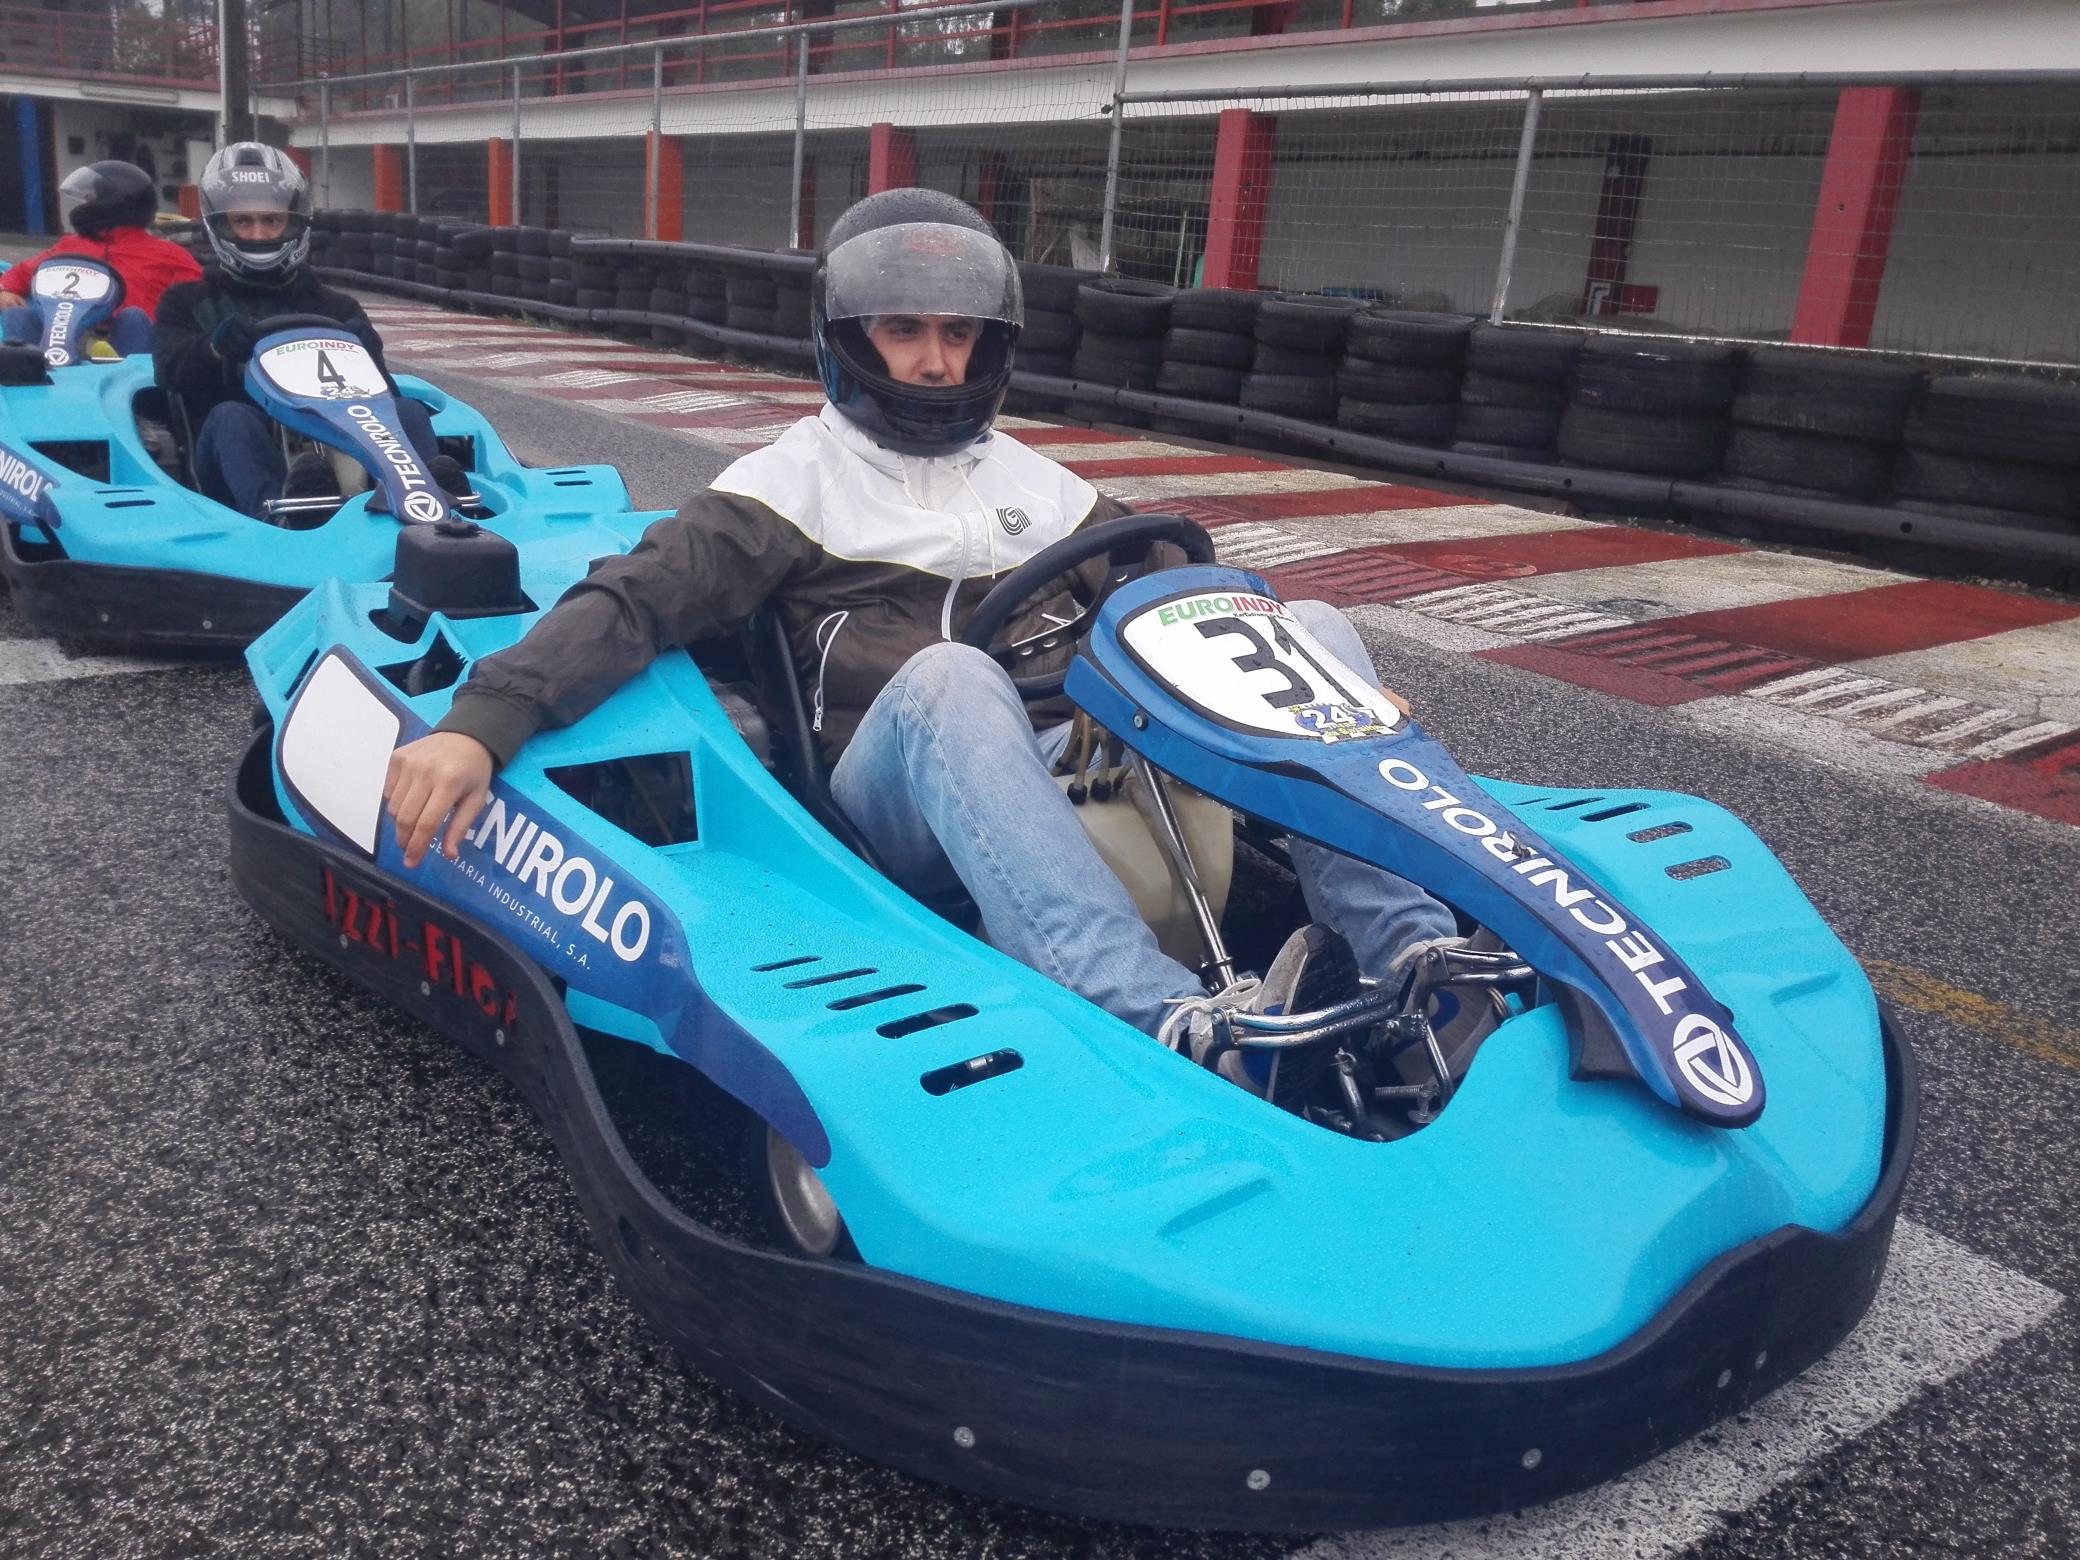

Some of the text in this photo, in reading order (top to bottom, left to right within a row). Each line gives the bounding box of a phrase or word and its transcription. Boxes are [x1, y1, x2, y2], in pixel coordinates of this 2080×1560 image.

[231, 171, 270, 183] SHOEI
[61, 271, 80, 295] 2
[275, 341, 356, 356] EUROINDY
[316, 349, 347, 389] 4
[346, 404, 427, 491] TECNIROLO
[1157, 596, 1286, 627] EUROINDY
[1193, 616, 1365, 709] 31
[1300, 706, 1357, 730] 24
[462, 789, 651, 963] NIROLO
[1378, 758, 1688, 1016] TECNIROLO
[487, 881, 562, 949] INDUSTRIAL,
[566, 943, 592, 971] S.A.
